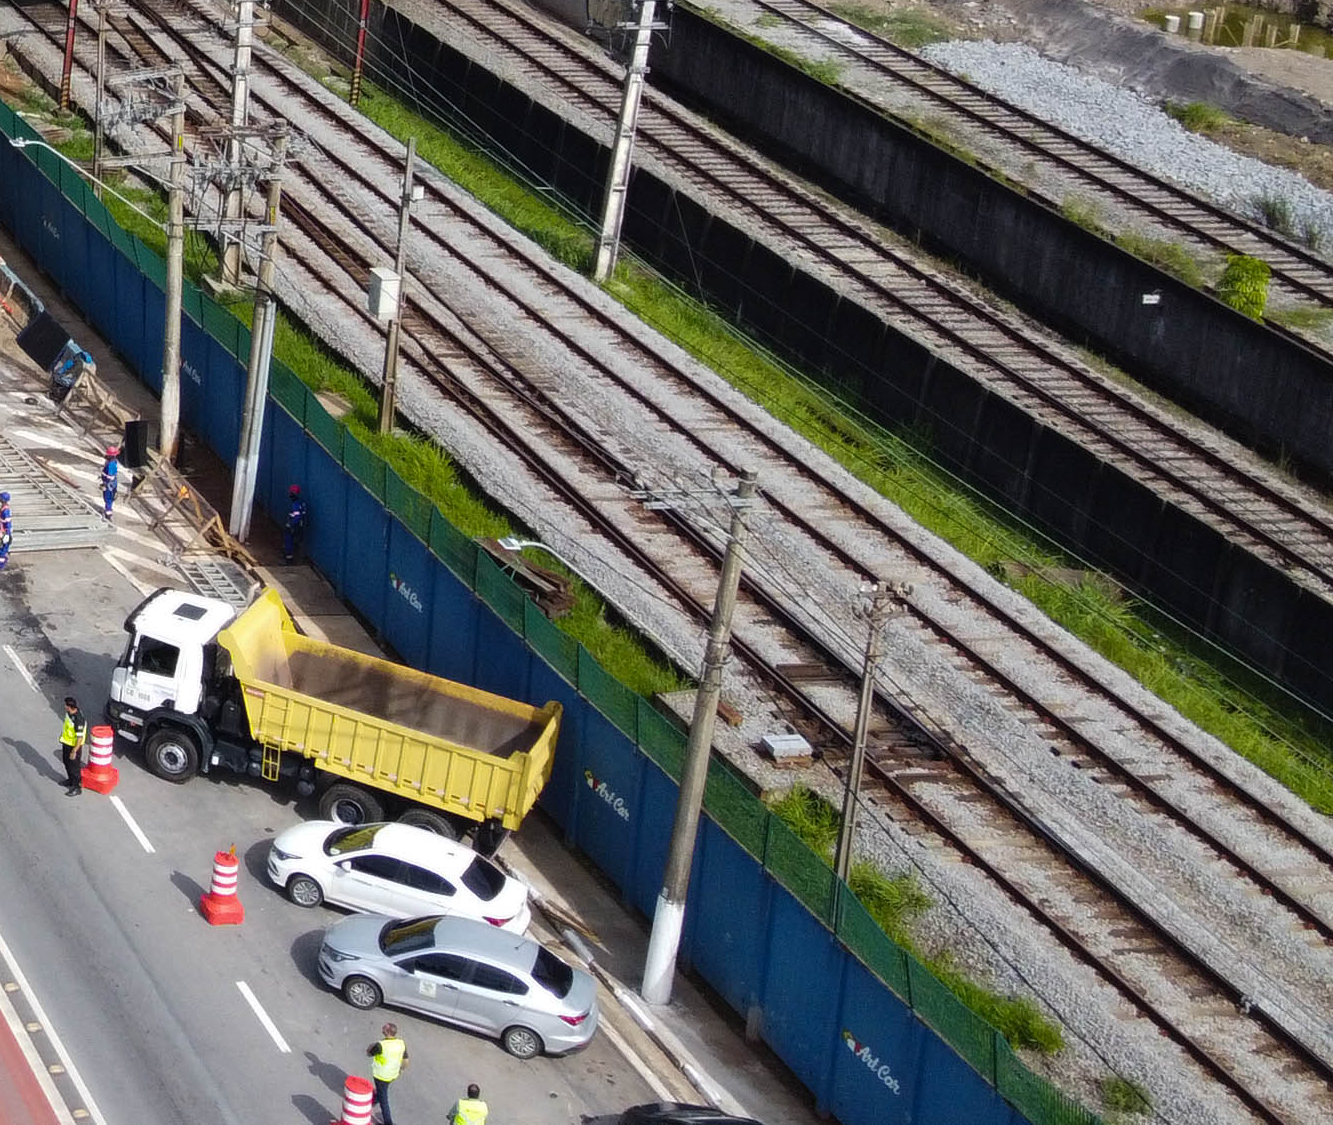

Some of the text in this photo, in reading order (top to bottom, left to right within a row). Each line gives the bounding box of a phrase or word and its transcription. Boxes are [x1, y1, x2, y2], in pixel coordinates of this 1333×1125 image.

[595, 782, 615, 805] Art
[855, 1046, 901, 1095] Art Car
